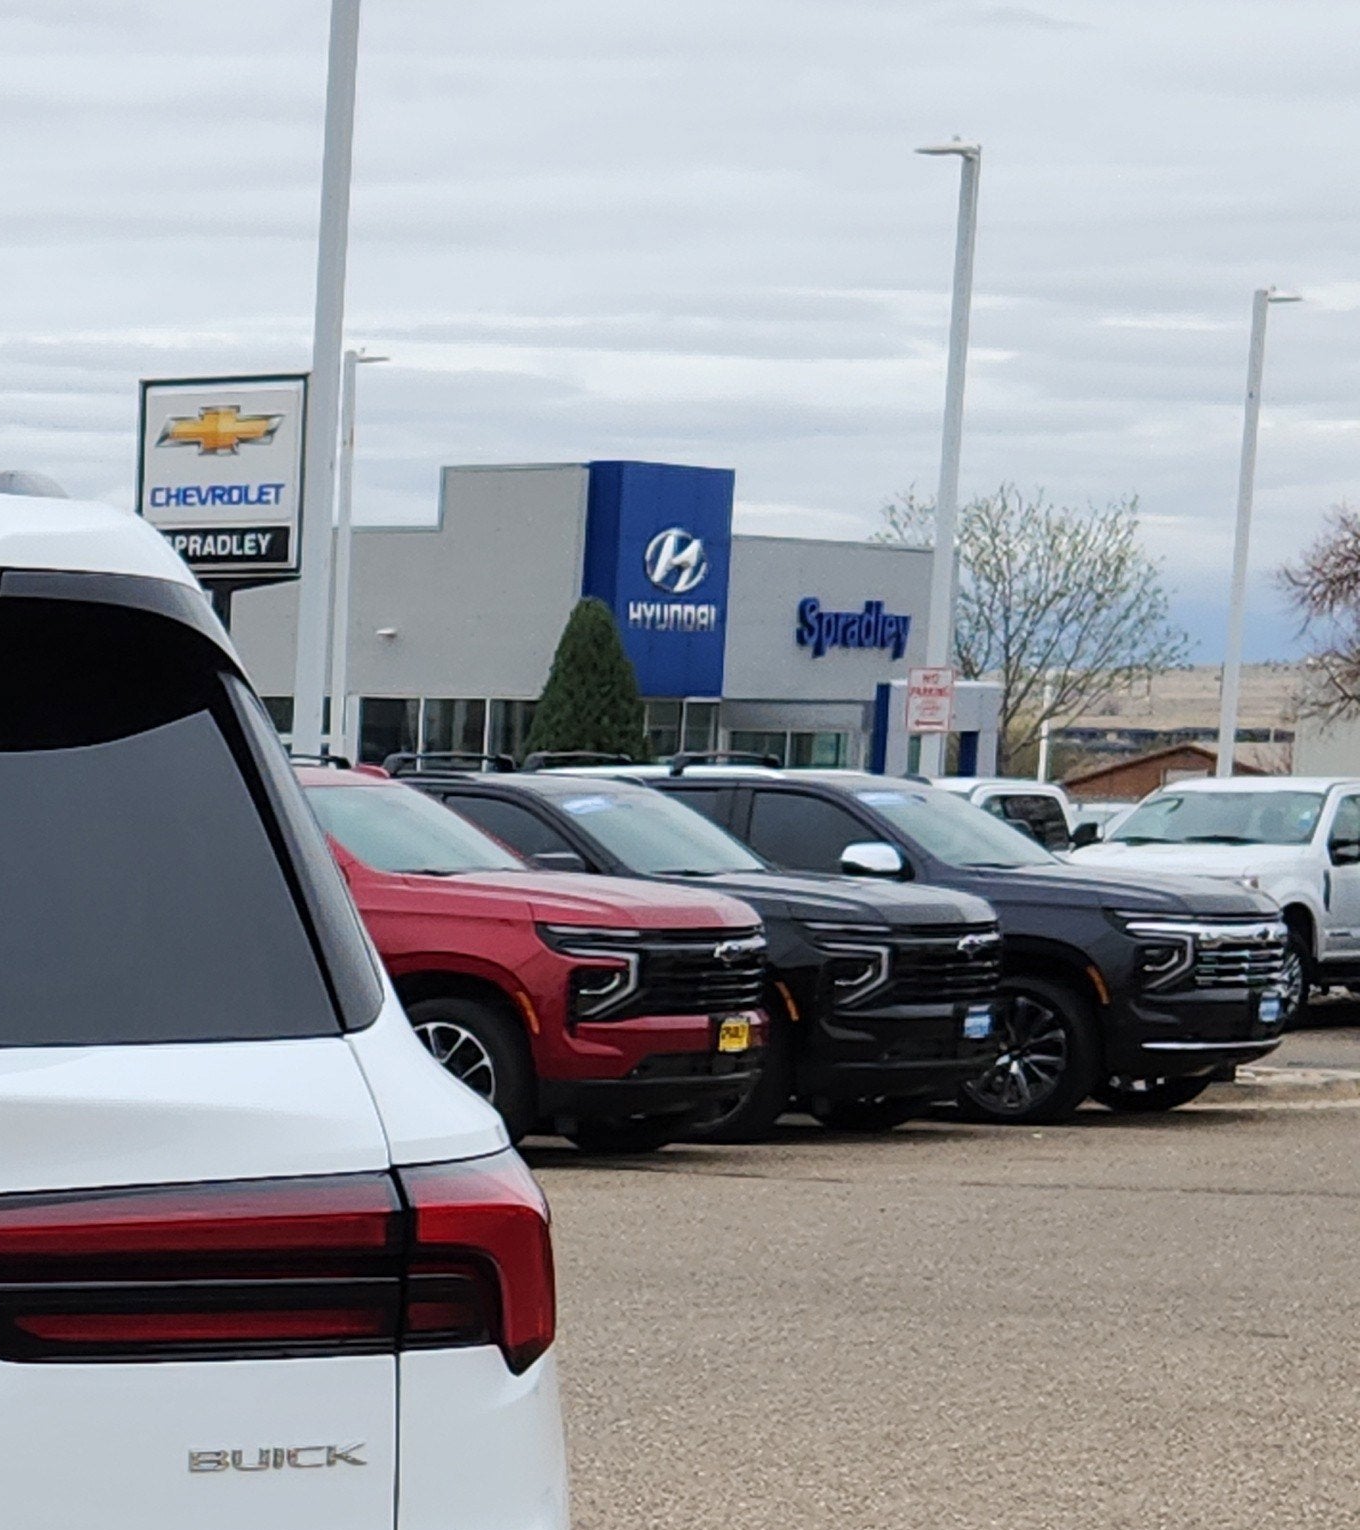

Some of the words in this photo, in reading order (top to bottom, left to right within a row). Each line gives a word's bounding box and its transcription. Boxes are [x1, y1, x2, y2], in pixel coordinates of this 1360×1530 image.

[149, 483, 285, 508] CHEVROLET
[629, 601, 716, 632] HYUNDAI
[796, 597, 911, 661] Spradley
[187, 1443, 368, 1474] BUICK
